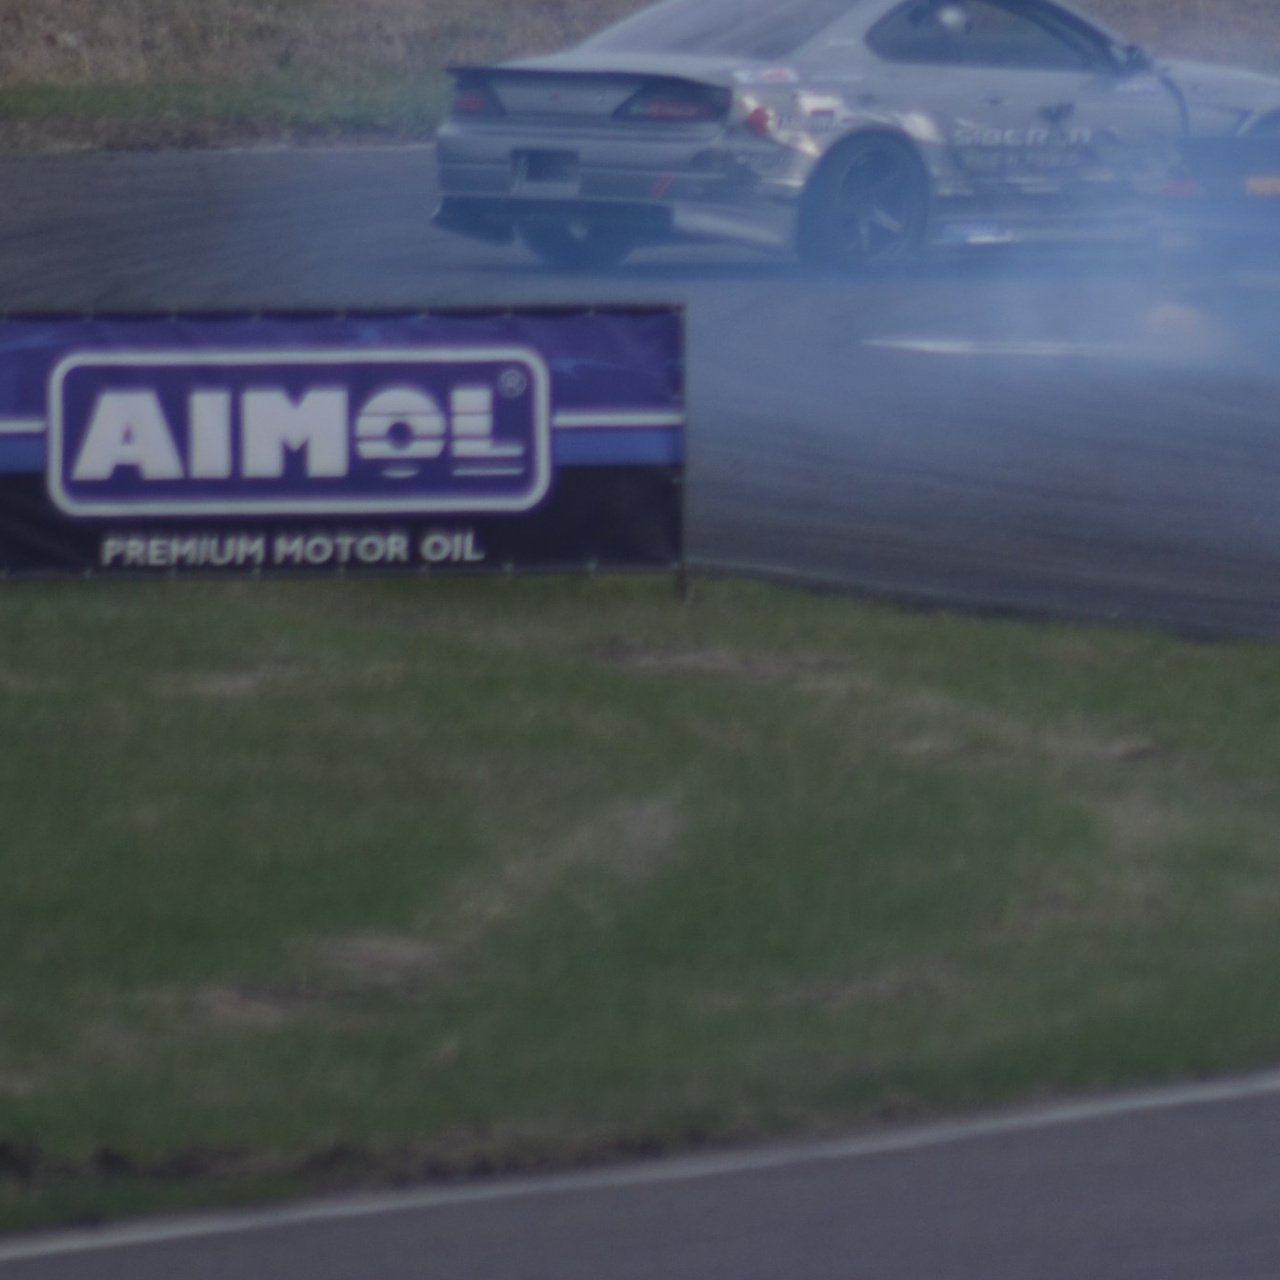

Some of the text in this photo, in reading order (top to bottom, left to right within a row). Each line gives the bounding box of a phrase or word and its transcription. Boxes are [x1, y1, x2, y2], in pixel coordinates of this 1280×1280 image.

[71, 387, 525, 480] AIMOL
[101, 532, 485, 567] PREMIUM MOTOR OIL
